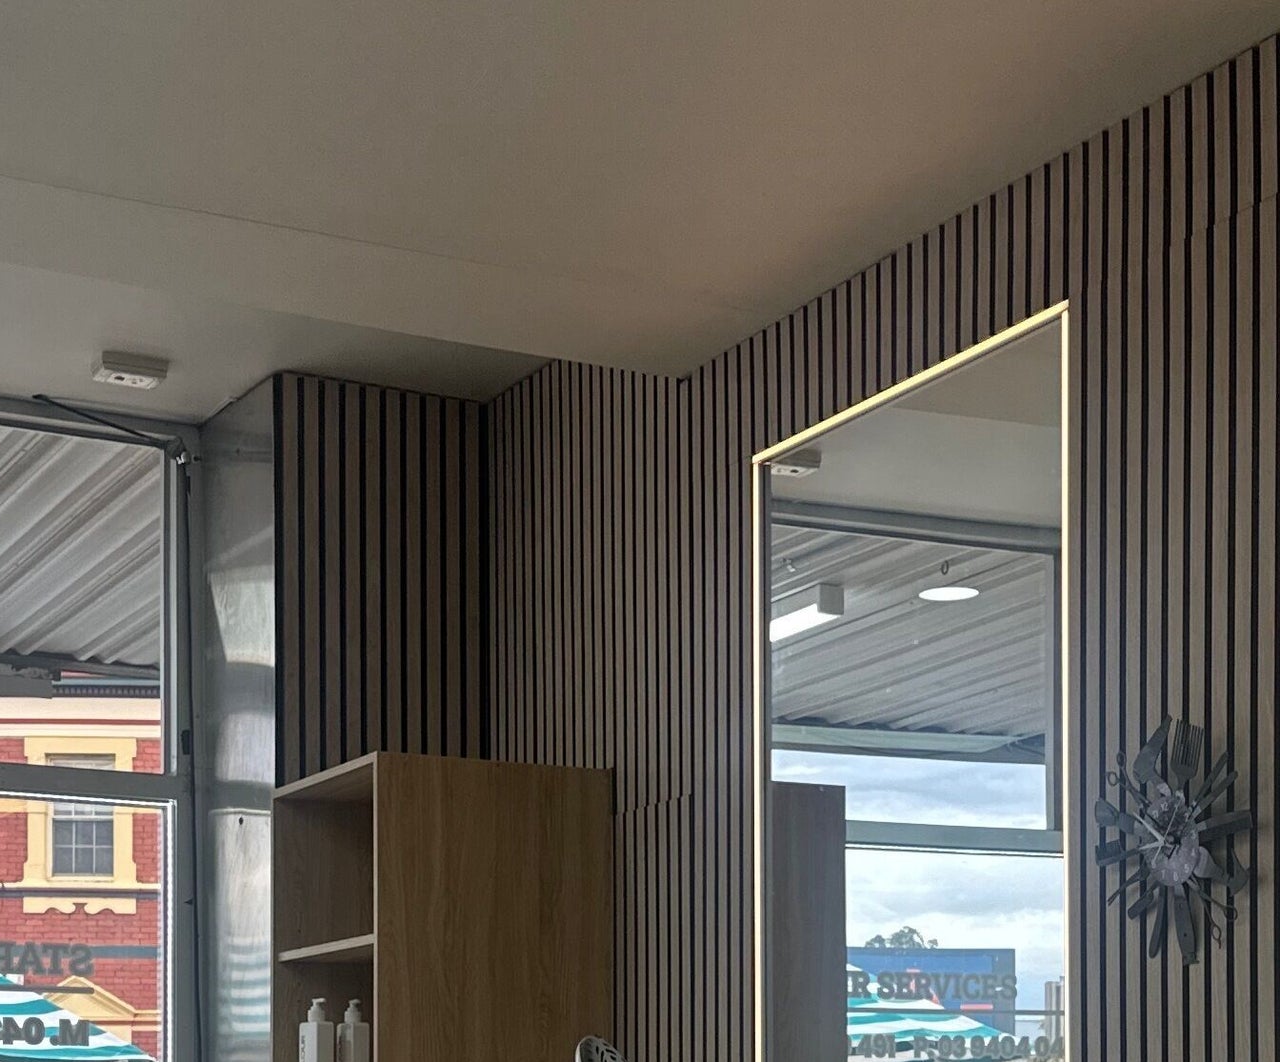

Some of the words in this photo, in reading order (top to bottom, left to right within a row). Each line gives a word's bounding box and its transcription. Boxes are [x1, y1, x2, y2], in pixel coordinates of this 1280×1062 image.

[876, 971, 1018, 1001] SERVICES
[858, 1034, 896, 1058] 491
[937, 1035, 967, 1059] 03
[969, 1035, 1030, 1059] 9404
